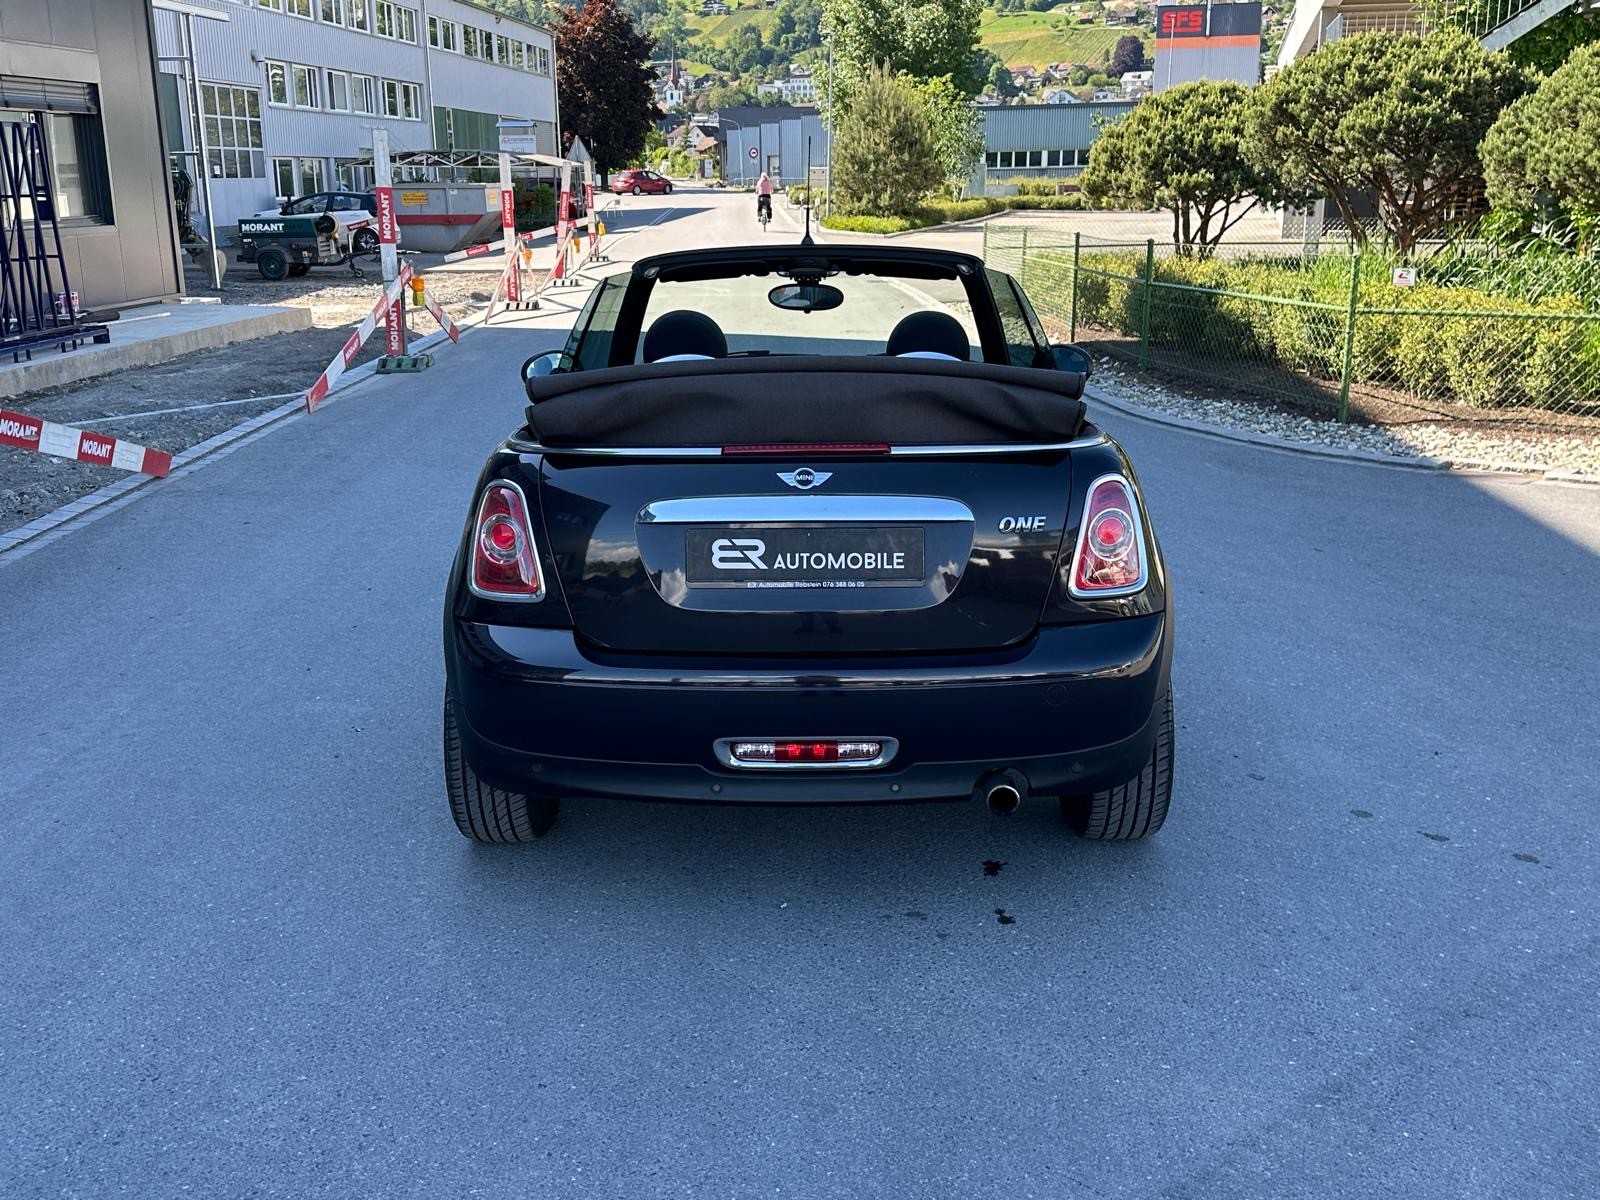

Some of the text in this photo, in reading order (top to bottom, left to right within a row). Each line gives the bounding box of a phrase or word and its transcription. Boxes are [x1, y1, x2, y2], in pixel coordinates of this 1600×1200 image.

[1162, 10, 1203, 30] SFS
[381, 193, 392, 239] MORANT
[504, 192, 512, 224] MORANT
[241, 223, 284, 232] MORANT
[0, 419, 38, 438] MORANT
[81, 439, 112, 458] MORANT
[999, 516, 1046, 532] ONE
[773, 553, 905, 569] AUTOMOBILE
